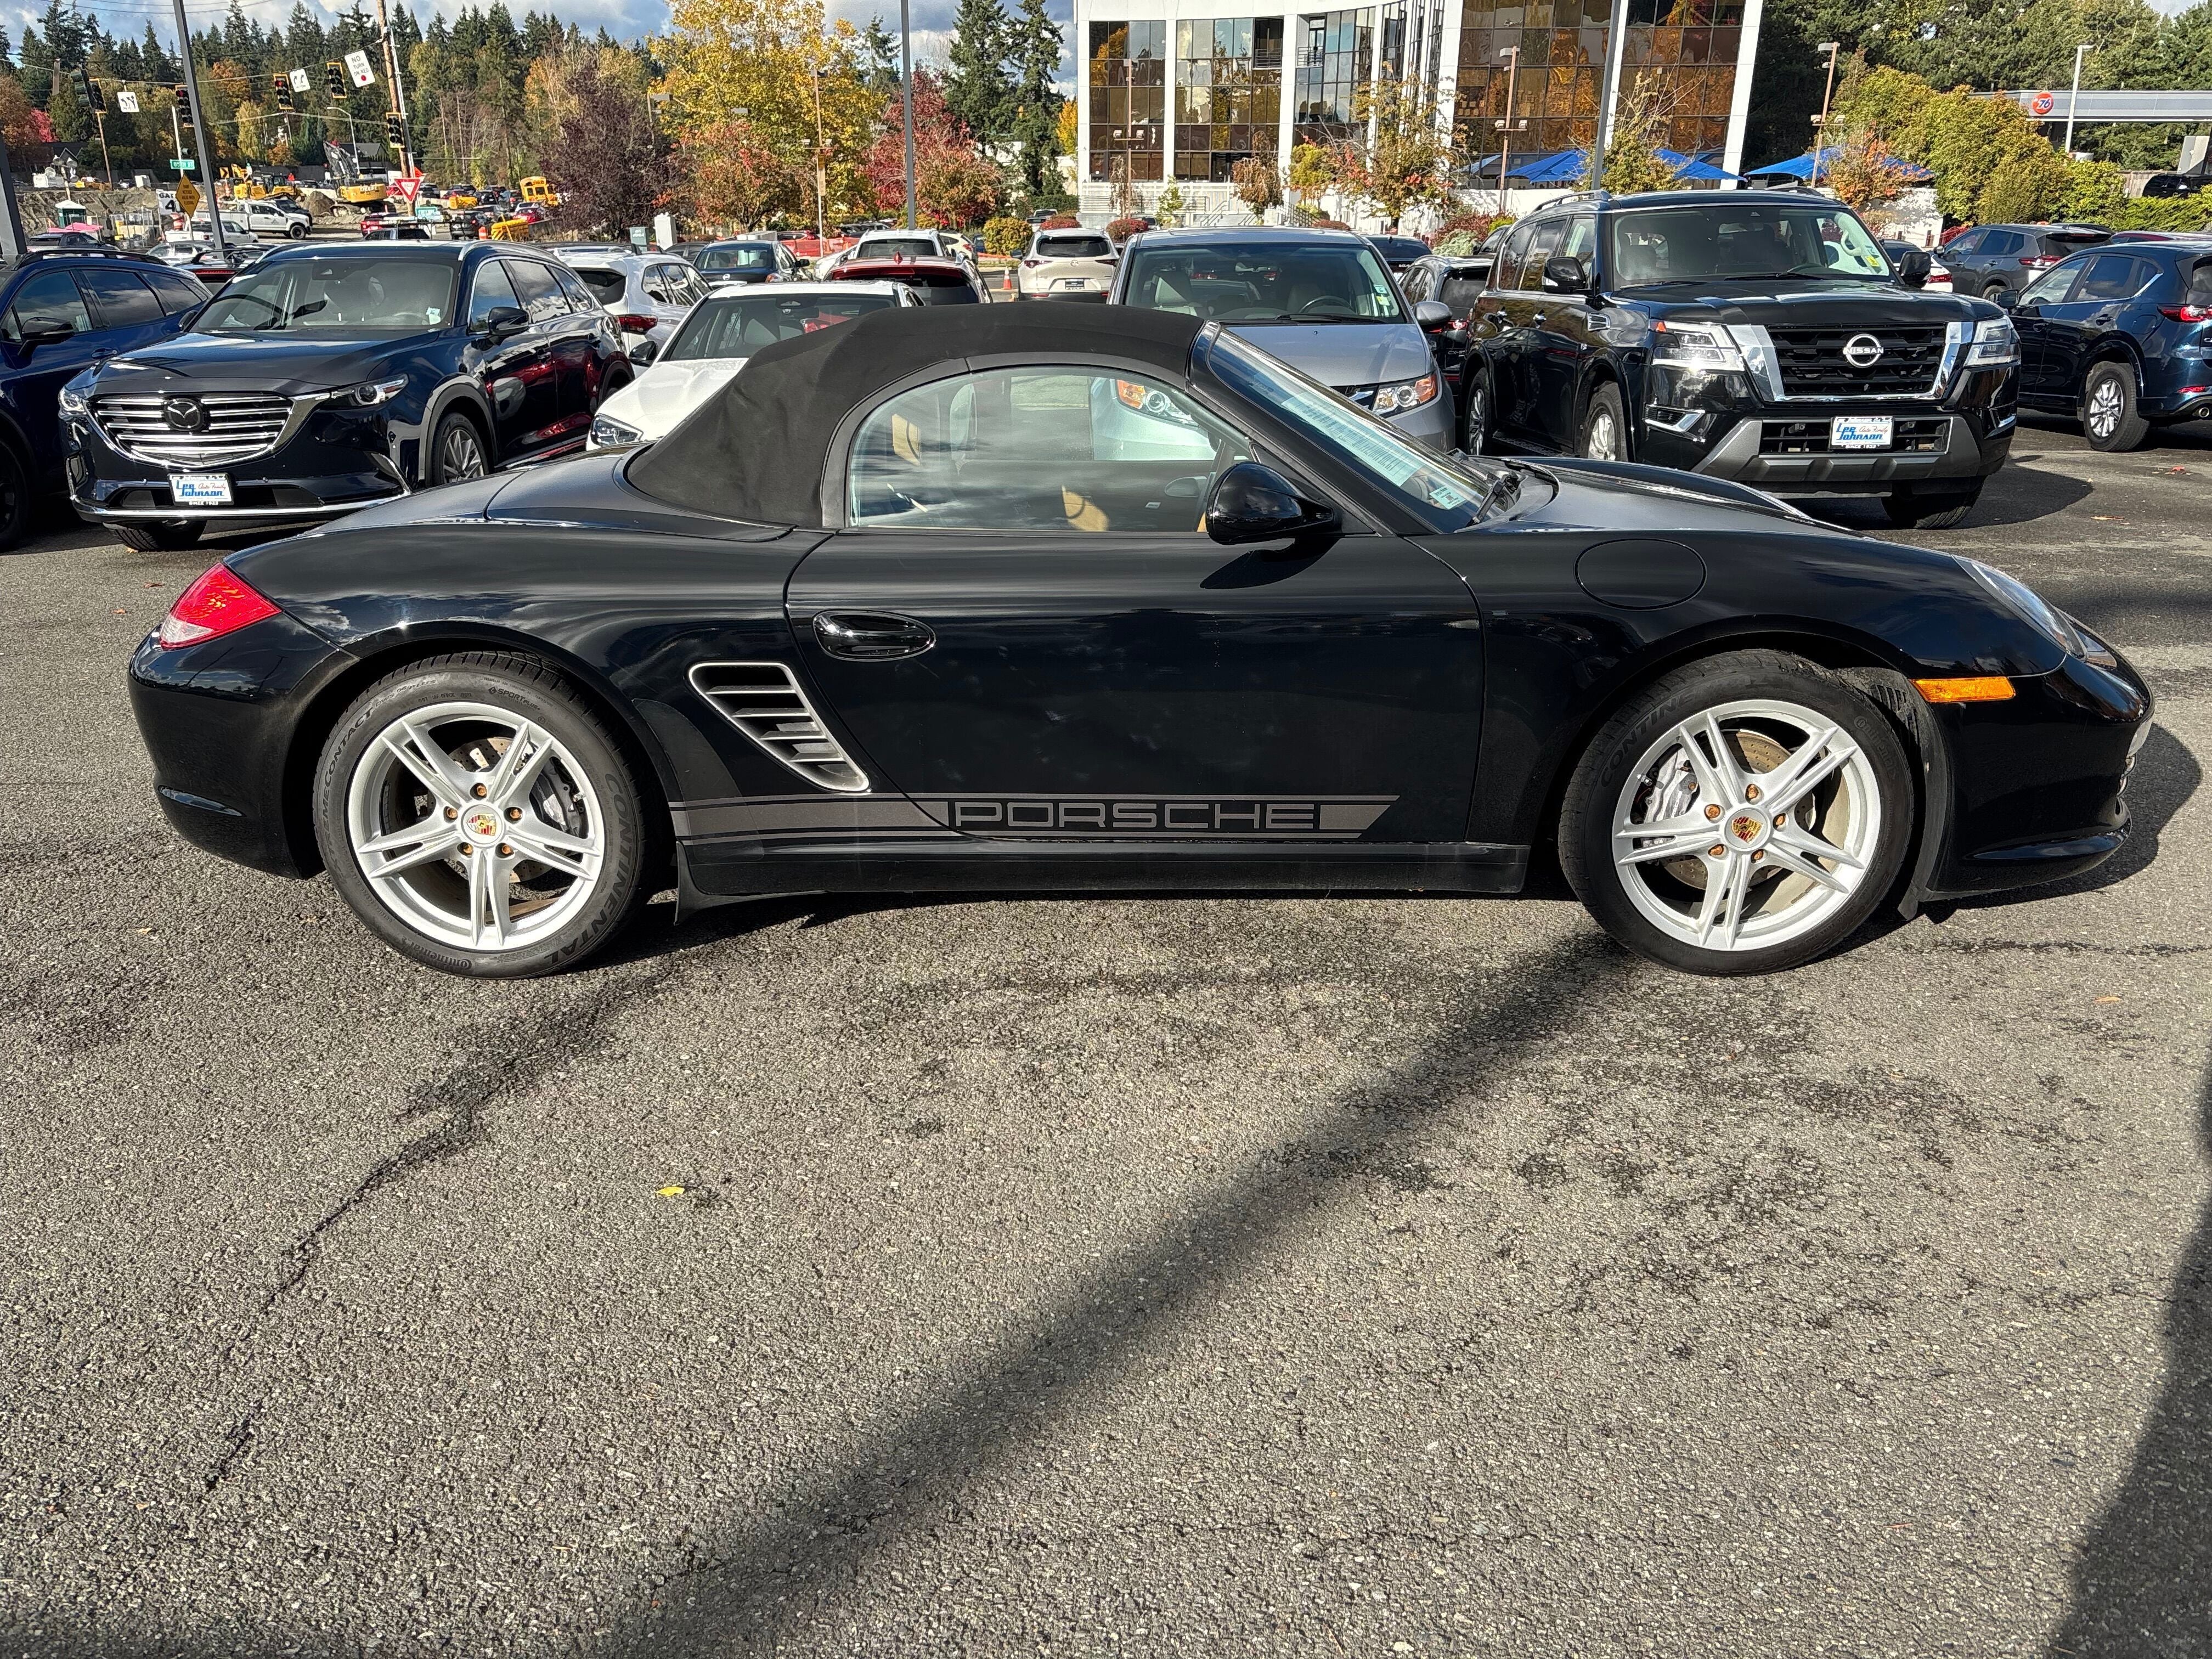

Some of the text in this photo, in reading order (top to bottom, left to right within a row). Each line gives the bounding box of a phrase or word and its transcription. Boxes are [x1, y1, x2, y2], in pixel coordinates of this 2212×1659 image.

[2038, 98, 2051, 109] 76
[165, 200, 175, 211] 4
[1836, 423, 1857, 432] Lee
[1836, 430, 1883, 440] Johnson
[176, 480, 196, 489] Lee
[179, 486, 224, 496] Johnson
[955, 801, 1314, 829] PORSCHE
[544, 774, 633, 964] CONTINENTAL
